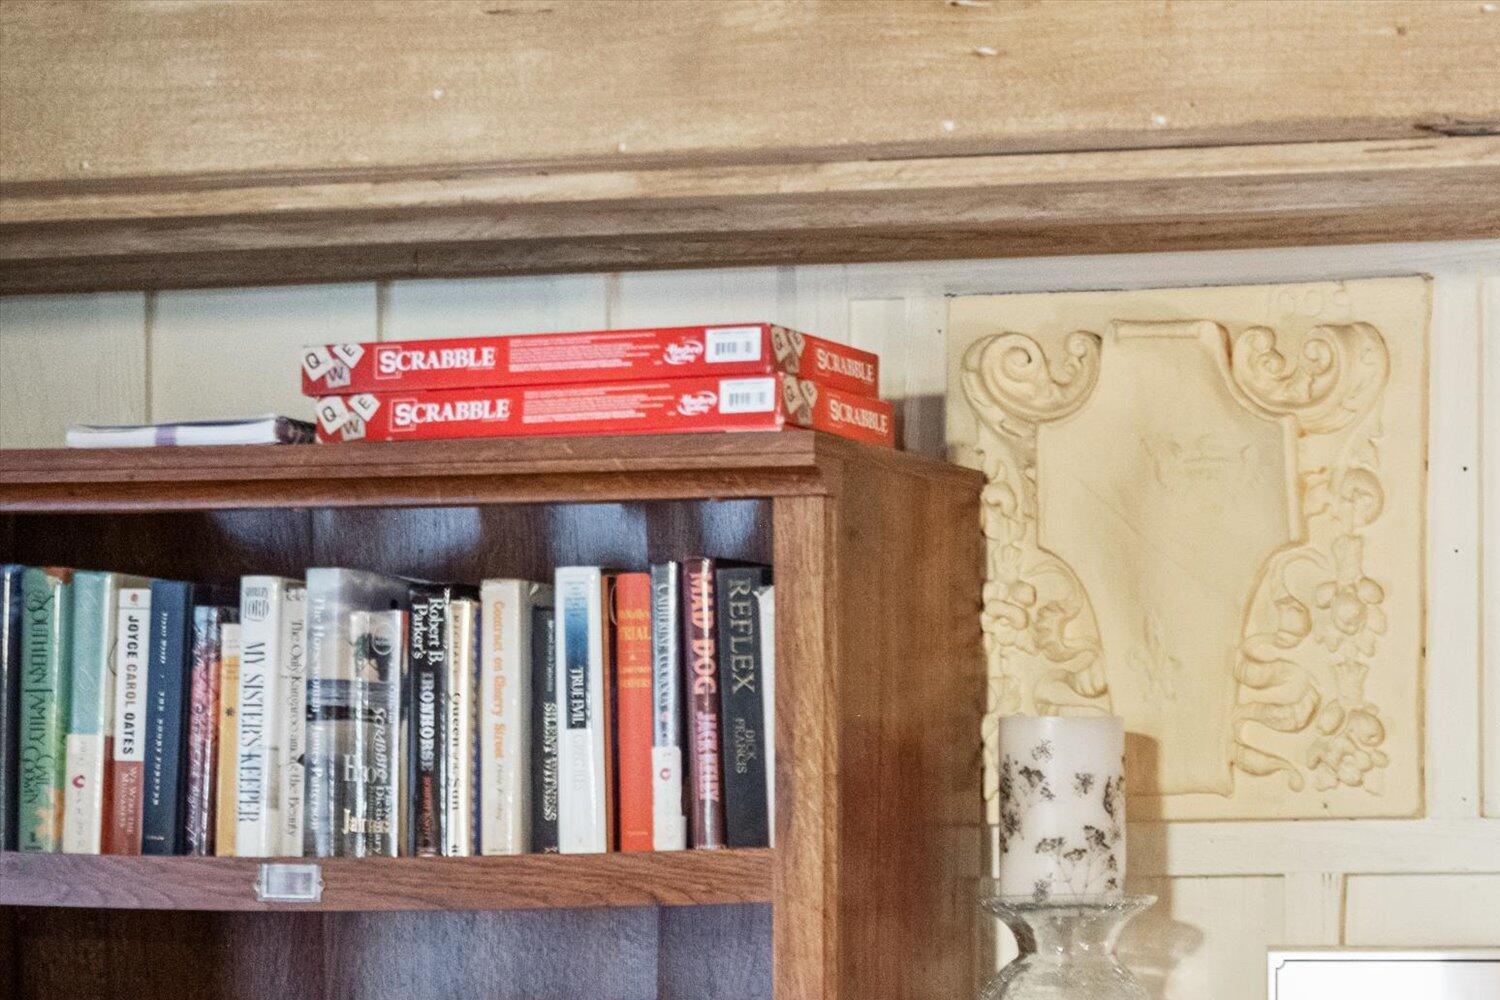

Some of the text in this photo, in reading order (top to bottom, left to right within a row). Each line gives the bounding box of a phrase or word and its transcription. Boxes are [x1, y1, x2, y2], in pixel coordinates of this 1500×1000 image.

[305, 352, 320, 369] Q
[379, 347, 496, 374] SCRABBLE
[816, 348, 875, 382] SCRABBLE
[322, 406, 336, 423] Q
[394, 398, 511, 426] SCRABBLE
[830, 399, 888, 434] SCRABBLE
[244, 642, 266, 668] MY
[412, 603, 427, 660] Parker's
[428, 598, 443, 666] Robert B.
[689, 571, 716, 696] MAD DOG
[728, 578, 755, 695] REFLEX
[24, 596, 54, 746] SOUTHERN FAMILY
[123, 616, 139, 754] JOYCE CAROL OATES
[570, 666, 584, 698] TRUE
[240, 674, 263, 748] SISTER'S
[420, 672, 434, 772] IRONHORSE
[544, 702, 556, 756] SILENT
[571, 700, 586, 725] EVIL
[239, 754, 260, 822] KEEPER
[544, 758, 558, 821] WITNESS
